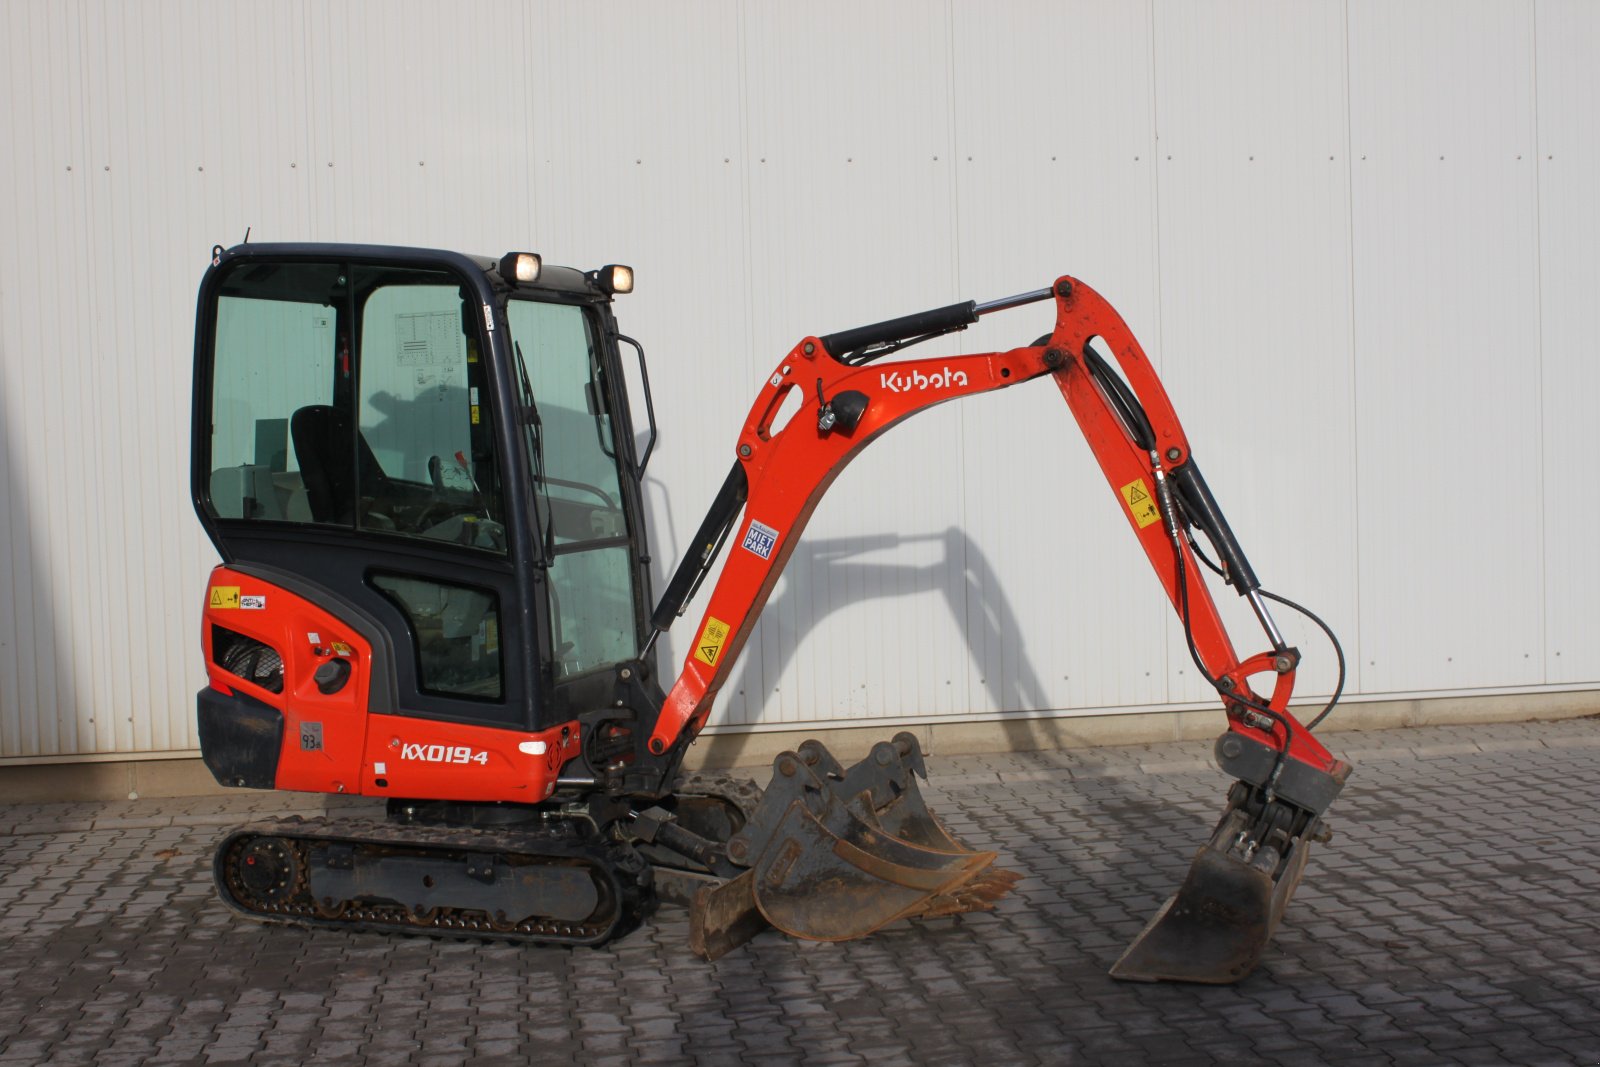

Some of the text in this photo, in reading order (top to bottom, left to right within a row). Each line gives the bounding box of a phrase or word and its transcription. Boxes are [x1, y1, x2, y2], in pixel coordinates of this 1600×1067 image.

[881, 367, 968, 392] Kubota
[745, 538, 769, 557] PARK
[749, 529, 773, 547] MIET
[401, 743, 488, 765] KX019-4
